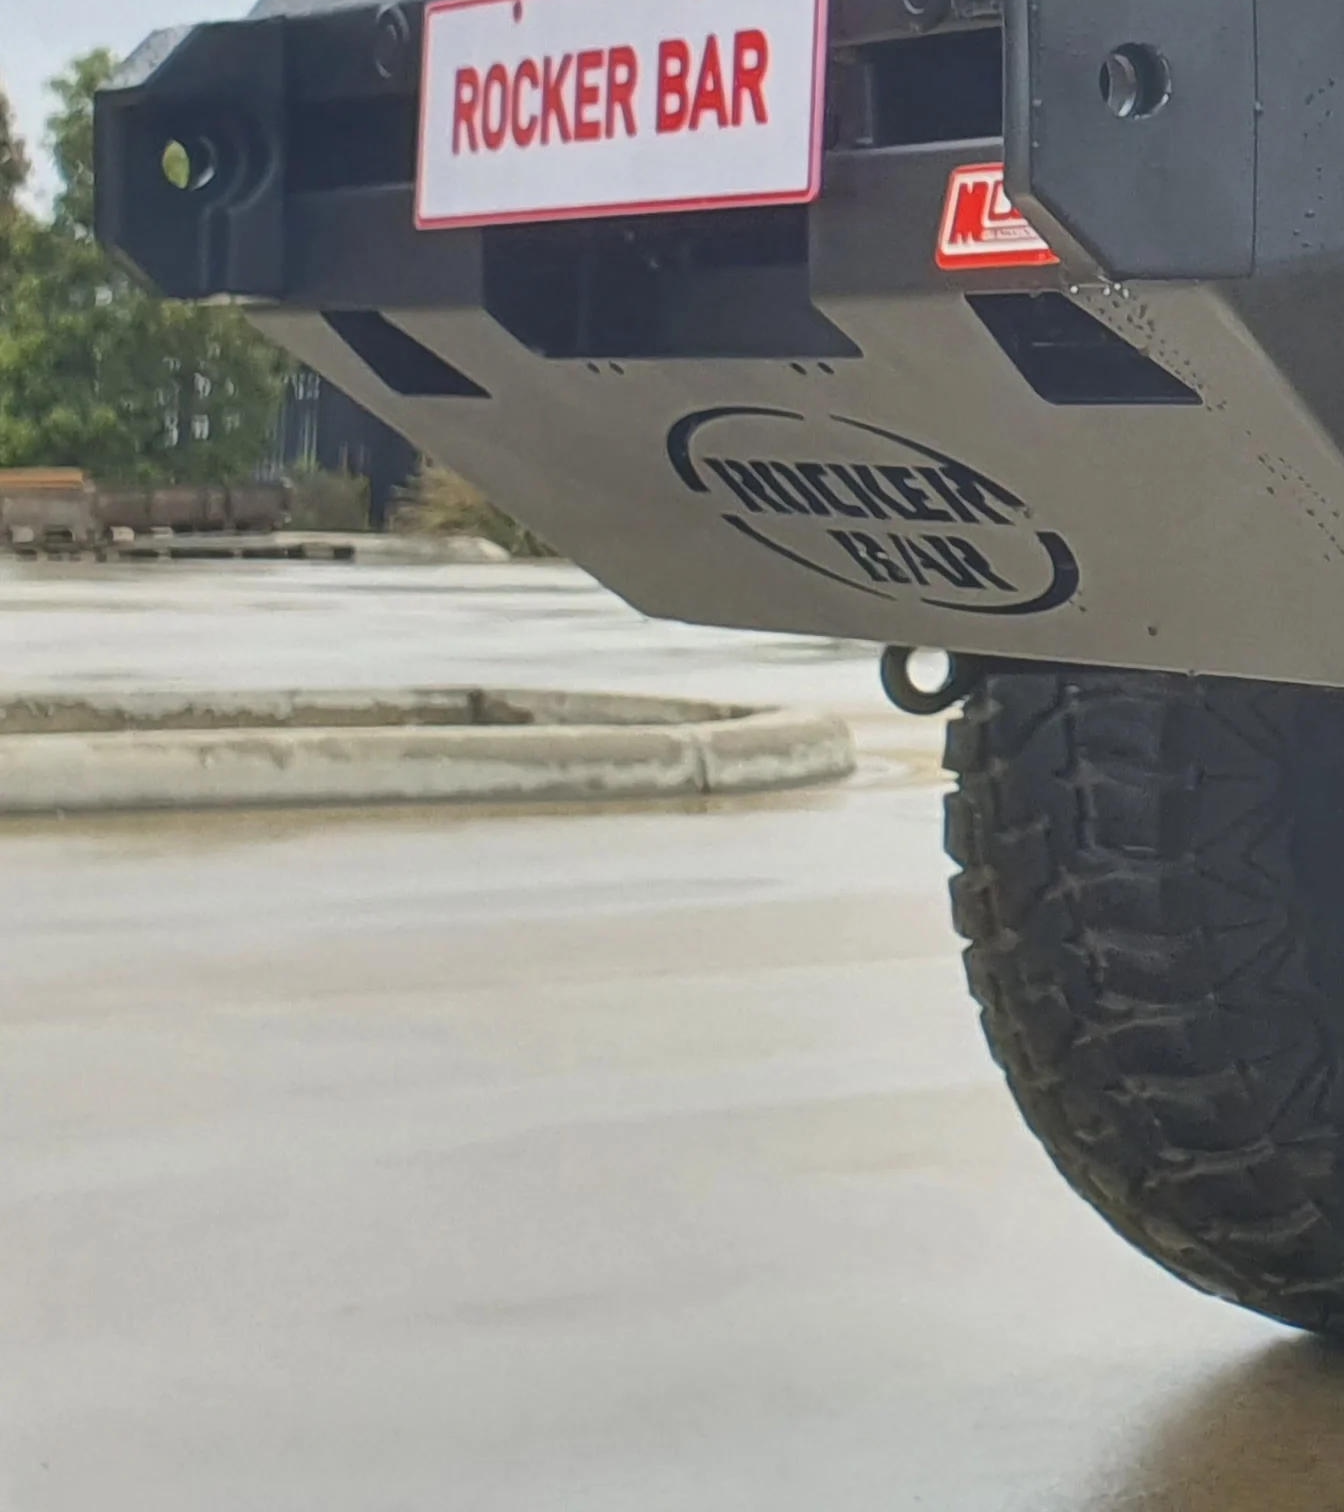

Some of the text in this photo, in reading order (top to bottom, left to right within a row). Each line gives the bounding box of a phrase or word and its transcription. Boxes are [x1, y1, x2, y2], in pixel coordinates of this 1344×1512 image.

[453, 29, 768, 155] ROCKER BAR
[704, 457, 1015, 526] ROCKER
[828, 529, 1018, 592] BAR
